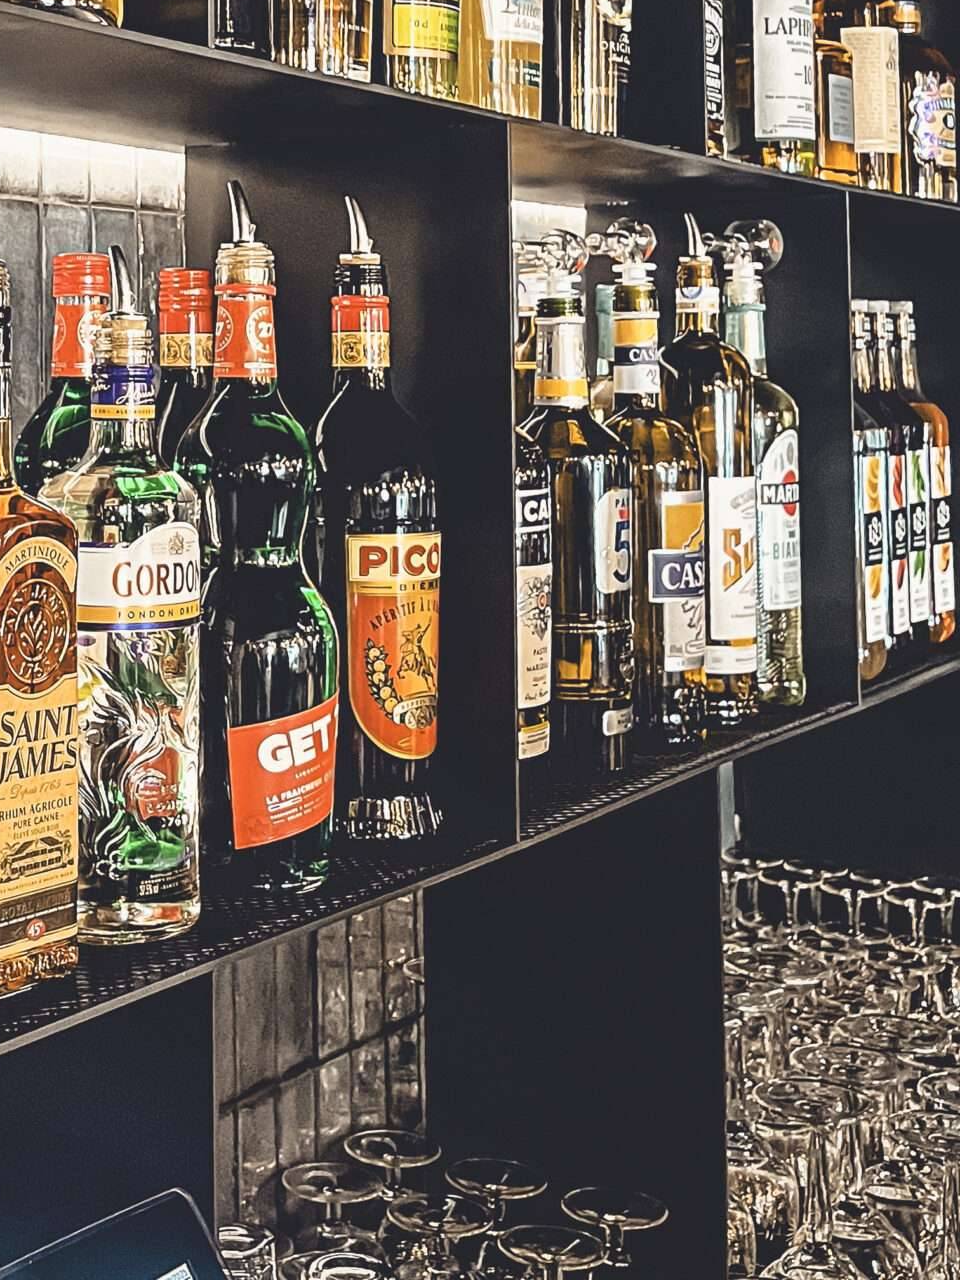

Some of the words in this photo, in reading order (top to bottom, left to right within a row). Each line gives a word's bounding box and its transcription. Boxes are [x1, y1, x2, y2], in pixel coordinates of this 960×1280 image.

[4, 546, 71, 575] MARTINIQUE
[258, 713, 332, 774] GET
[28, 796, 73, 817] AGRICOLE
[266, 794, 279, 806] LA
[13, 818, 32, 831] PURE
[33, 811, 60, 828] CANNE
